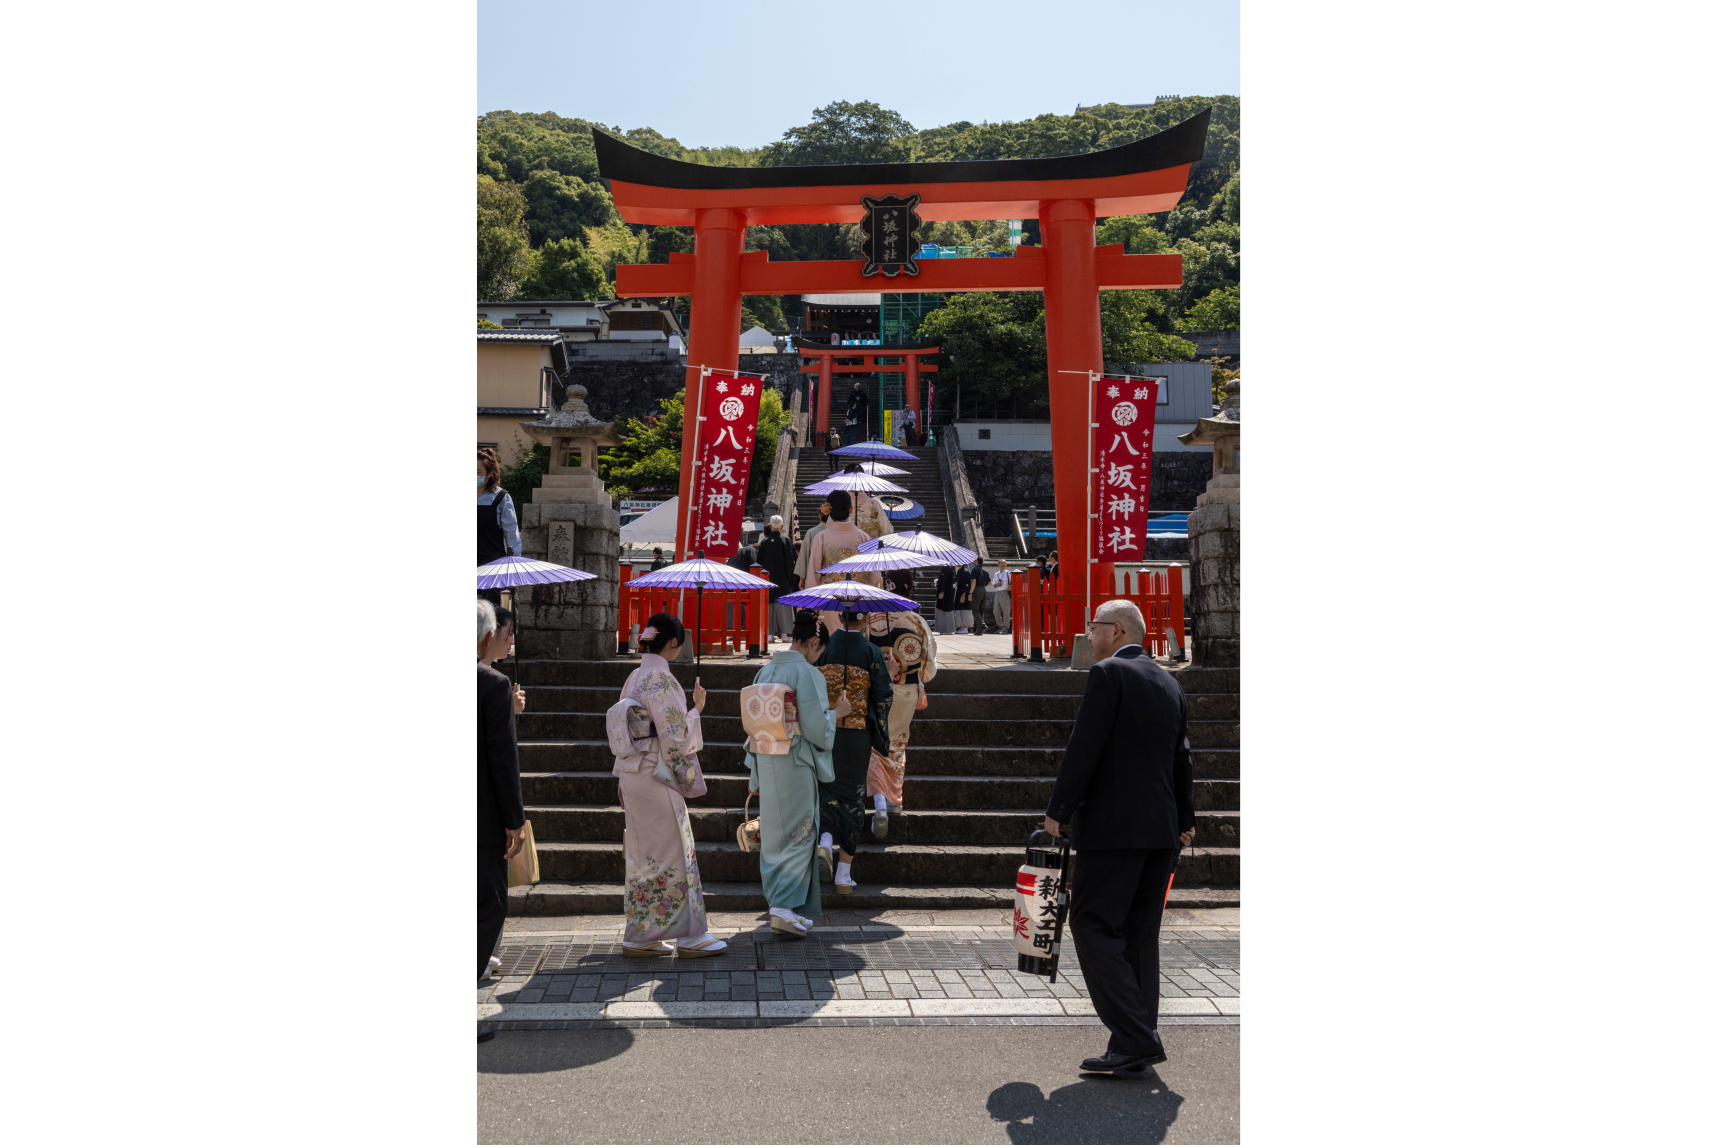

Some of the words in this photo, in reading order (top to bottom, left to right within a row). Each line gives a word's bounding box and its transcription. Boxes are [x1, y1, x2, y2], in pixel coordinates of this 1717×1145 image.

[882, 209, 900, 262] 八坂神社
[715, 380, 755, 396] 奉納
[1106, 385, 1149, 400] 奉納
[701, 425, 743, 548] 八坂神社
[737, 423, 754, 506] 令和三年一月吉日
[1106, 431, 1140, 554] 八坂神社
[1139, 428, 1150, 513] 令和三年一月吉日
[1032, 875, 1061, 955] 新大工町
